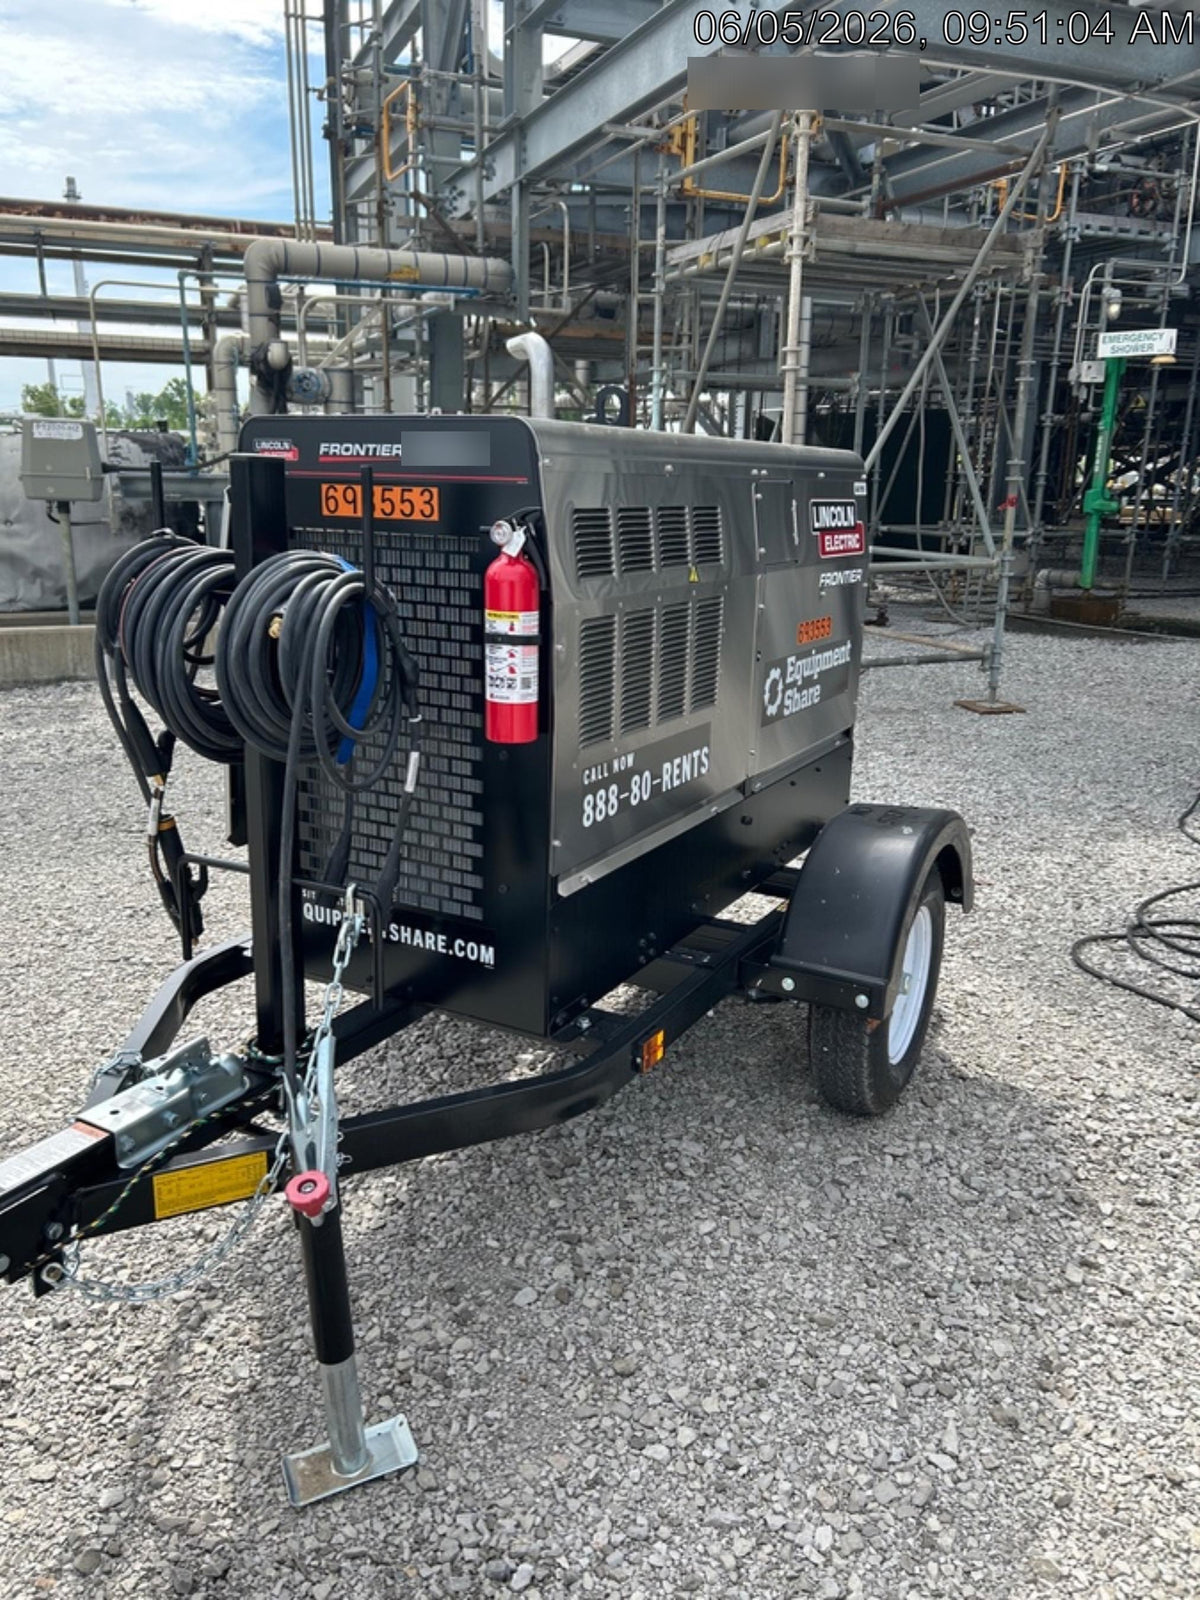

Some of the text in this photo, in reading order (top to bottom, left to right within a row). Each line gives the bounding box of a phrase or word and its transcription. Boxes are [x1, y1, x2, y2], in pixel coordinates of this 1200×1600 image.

[1102, 332, 1165, 344] EMERGENCY
[1110, 342, 1154, 354] SHOWER
[255, 440, 292, 450] LINCOLN
[319, 443, 402, 456] FRONTIER
[324, 484, 435, 518] 69553
[812, 506, 855, 528] LINCOLN
[824, 533, 861, 552] ELECTRIC
[819, 568, 863, 587] FRONTIER
[785, 640, 852, 685] Equipment
[783, 684, 821, 716] Share
[583, 752, 635, 785] CALL NOW
[582, 746, 710, 828] 888-80-RENTS
